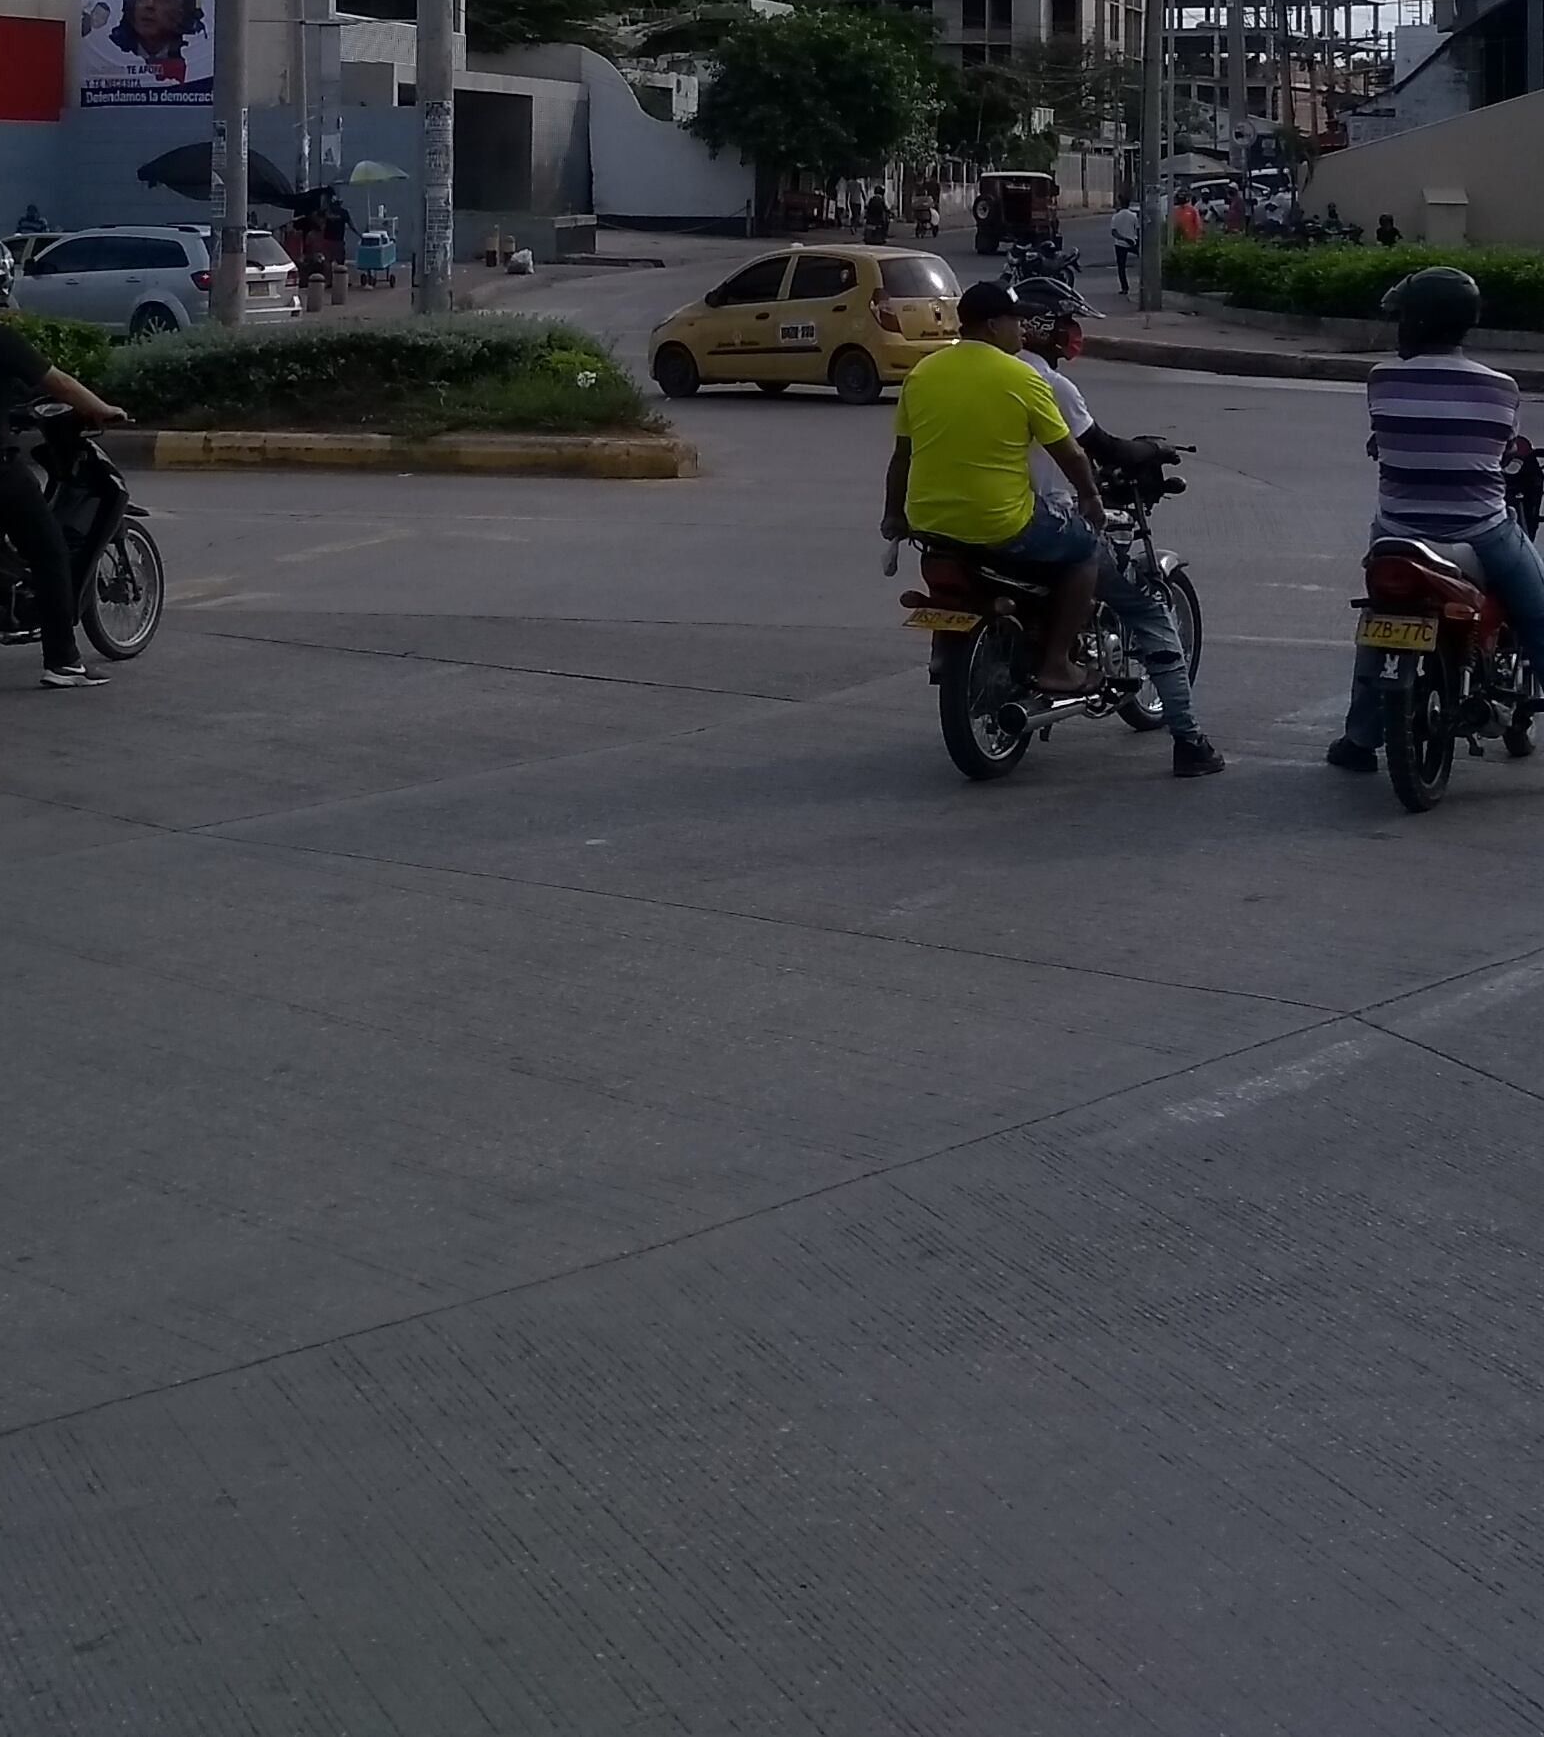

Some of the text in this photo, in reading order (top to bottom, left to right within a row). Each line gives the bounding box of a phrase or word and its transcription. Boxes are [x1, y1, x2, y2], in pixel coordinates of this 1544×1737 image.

[86, 90, 214, 103] Defendamos la democraci
